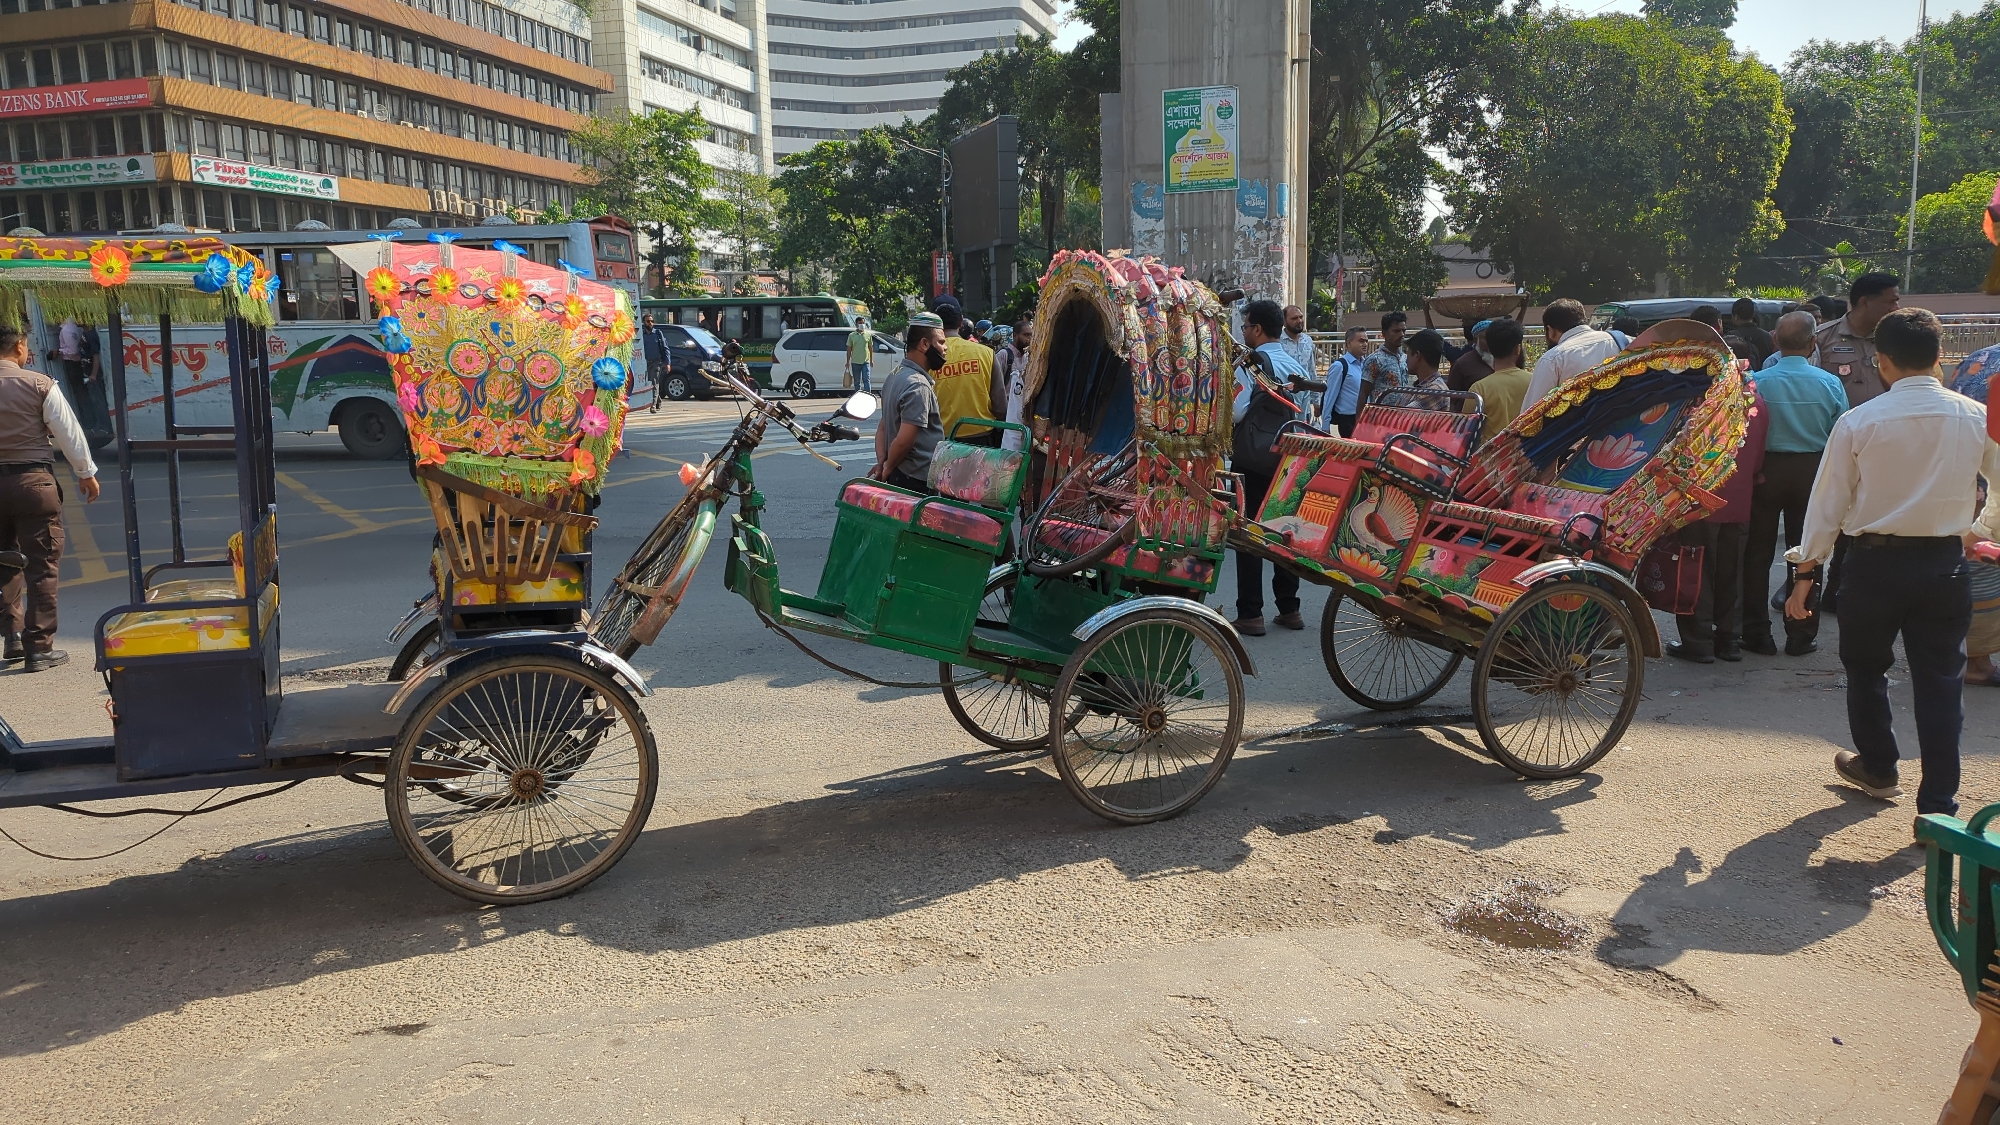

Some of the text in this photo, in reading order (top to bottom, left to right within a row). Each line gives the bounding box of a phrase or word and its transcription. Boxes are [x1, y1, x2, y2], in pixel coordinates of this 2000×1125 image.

[44, 89, 89, 109] BANK
[1166, 104, 1200, 118] এশায়াত
[1167, 118, 1196, 130] সম্মেলন
[1206, 152, 1229, 161] আজম
[20, 162, 93, 176] Finance
[214, 161, 246, 175] First
[249, 166, 298, 183] Finance
[935, 359, 979, 379] POLICE
